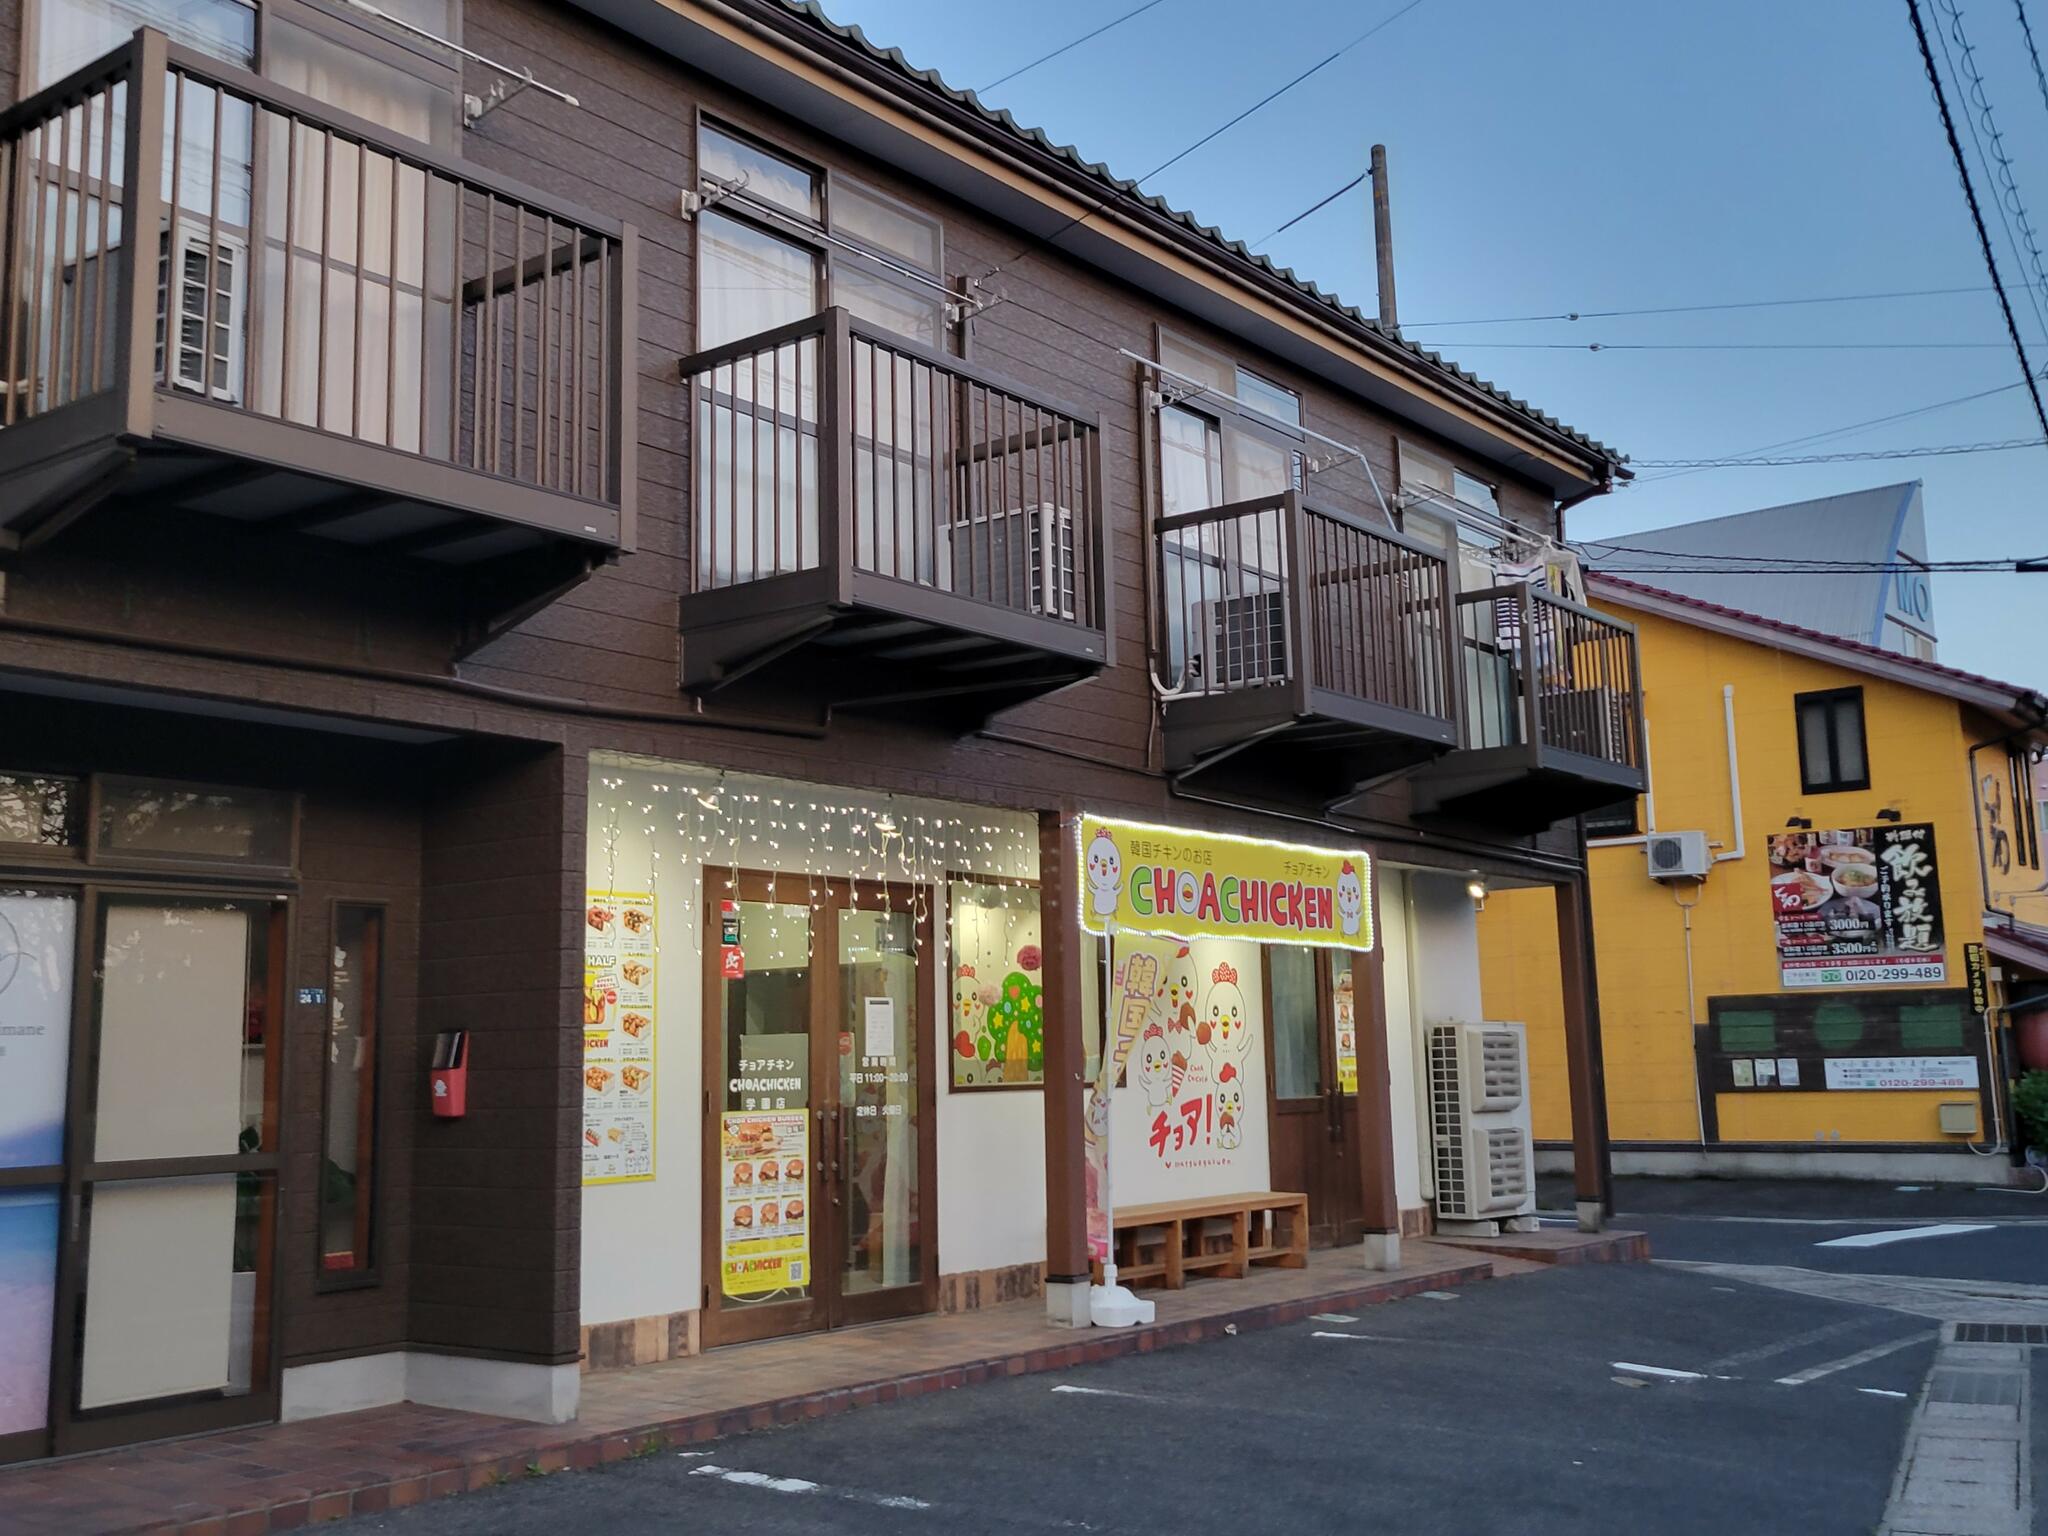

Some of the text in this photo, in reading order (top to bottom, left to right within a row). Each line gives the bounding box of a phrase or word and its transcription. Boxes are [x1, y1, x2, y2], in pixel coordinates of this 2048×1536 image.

[1130, 840, 1213, 867] 韓国チキンのお店
[1283, 860, 1331, 881] チョアチキン
[1130, 866, 1334, 931] CHOACHICKEN
[1880, 843, 1941, 952] 飲み放題
[587, 954, 616, 966] HALF
[1846, 966, 1942, 981] 0120-299-489
[739, 1059, 795, 1071] チョアチキン
[729, 1077, 802, 1093] CHOACHICKEN
